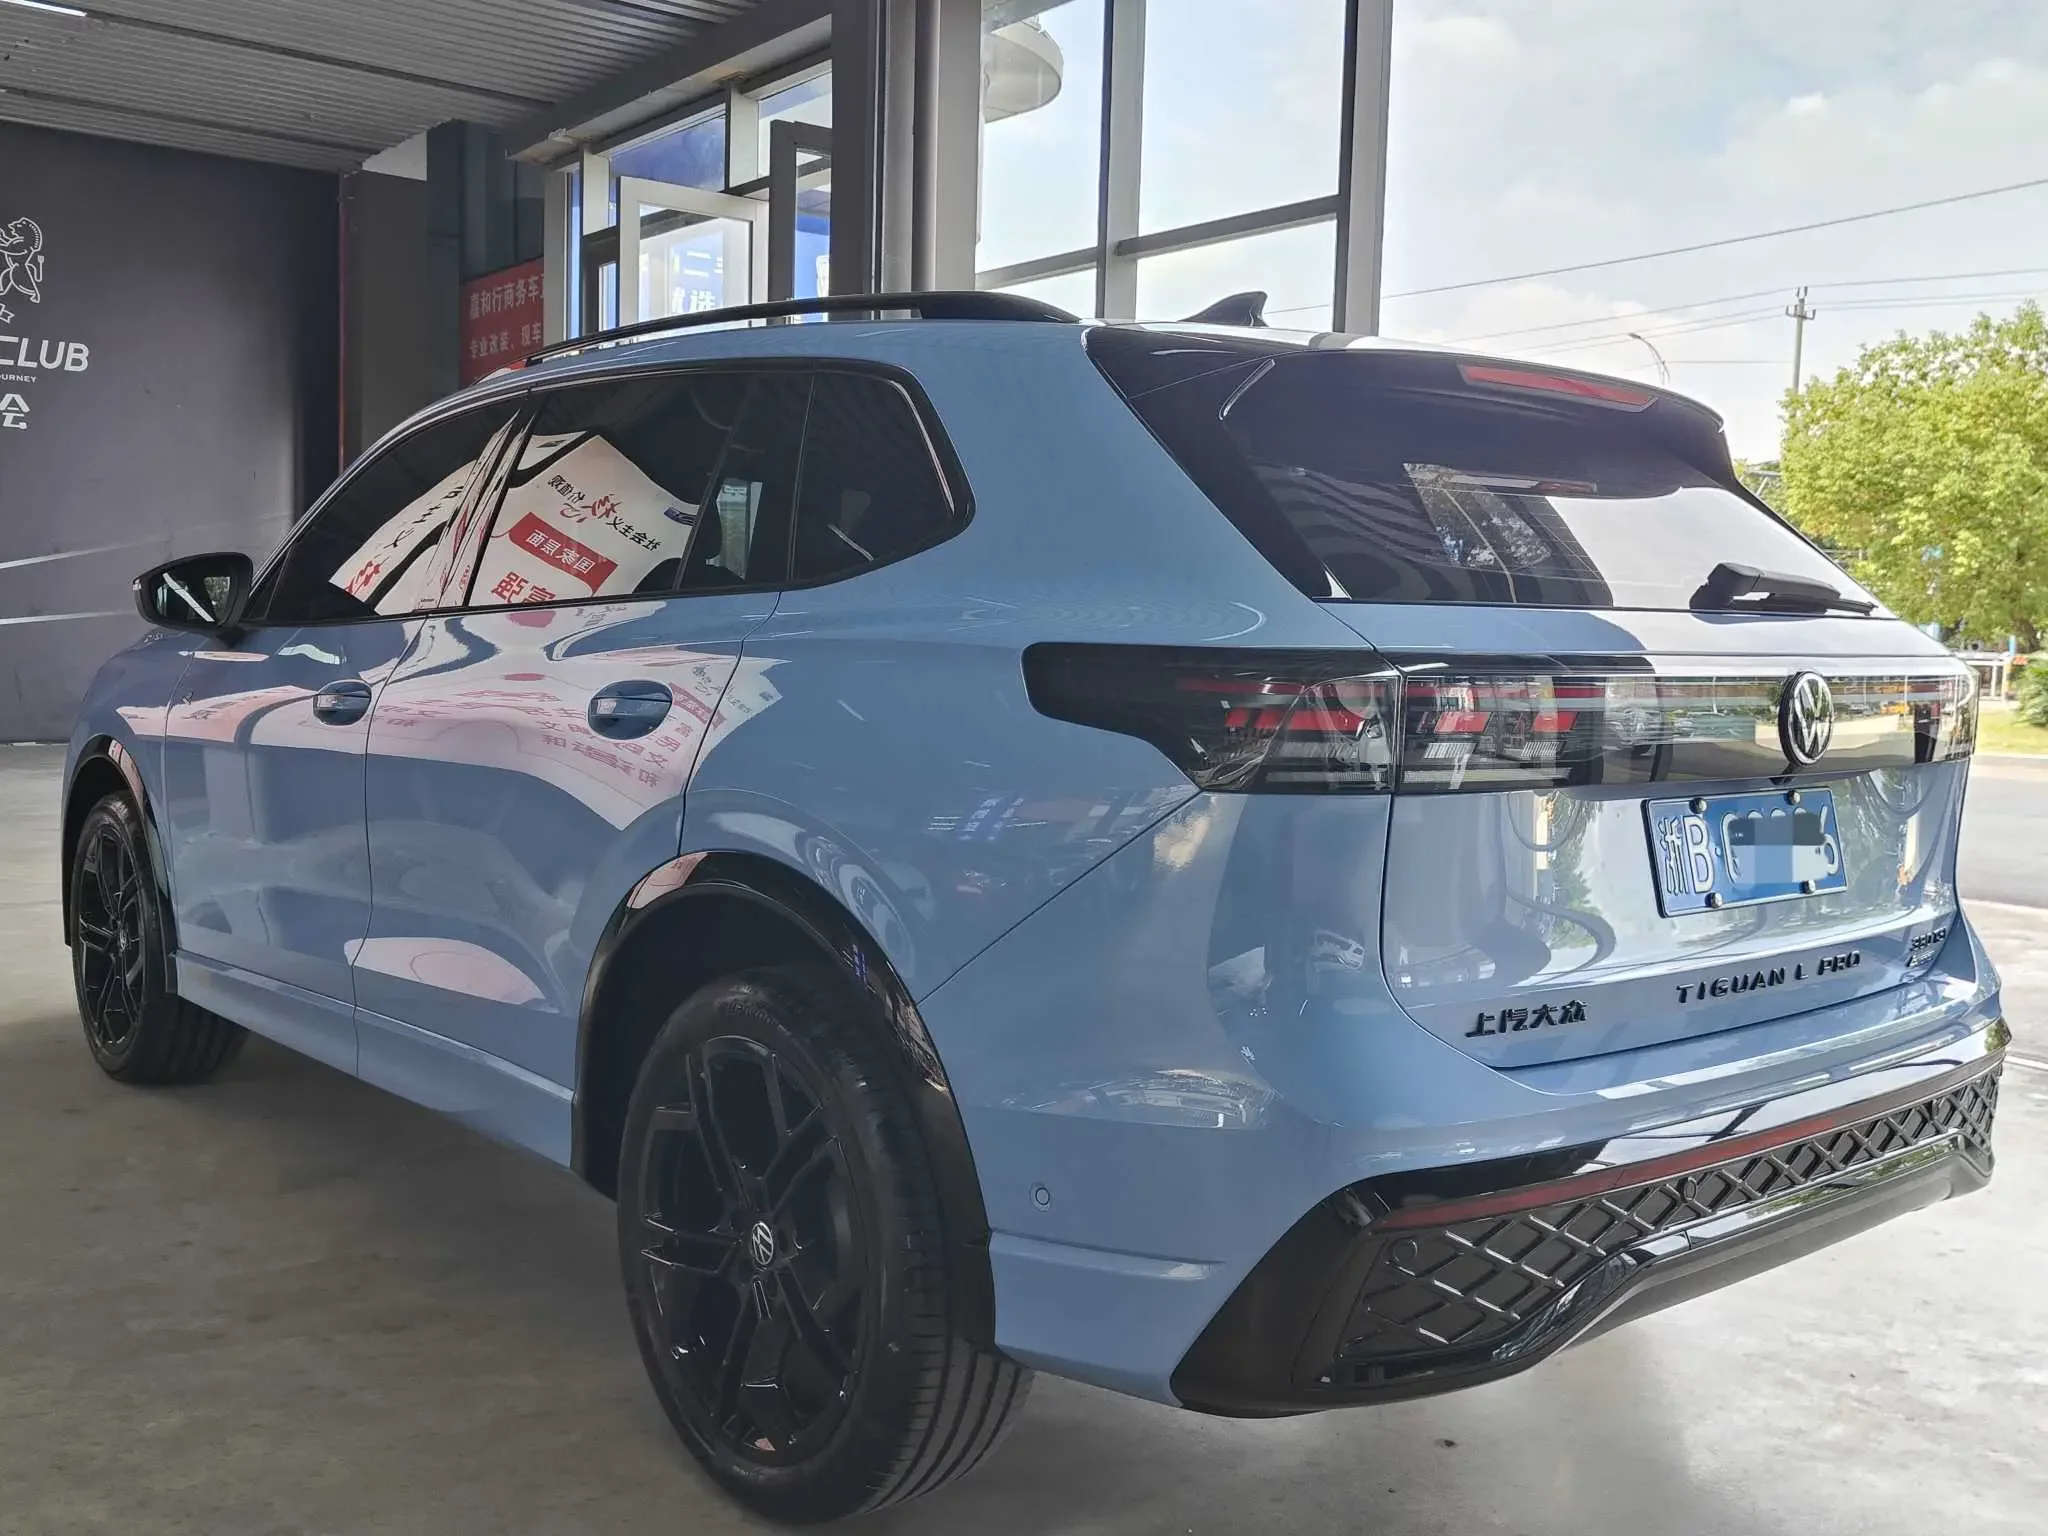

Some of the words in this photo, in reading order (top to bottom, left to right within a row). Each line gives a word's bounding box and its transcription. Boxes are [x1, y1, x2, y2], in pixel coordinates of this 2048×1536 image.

[1675, 967, 1786, 1004] TIGUAN
[1794, 961, 1810, 981] L
[1817, 950, 1862, 977] PRO
[1465, 999, 1589, 1038] 上汽大众
